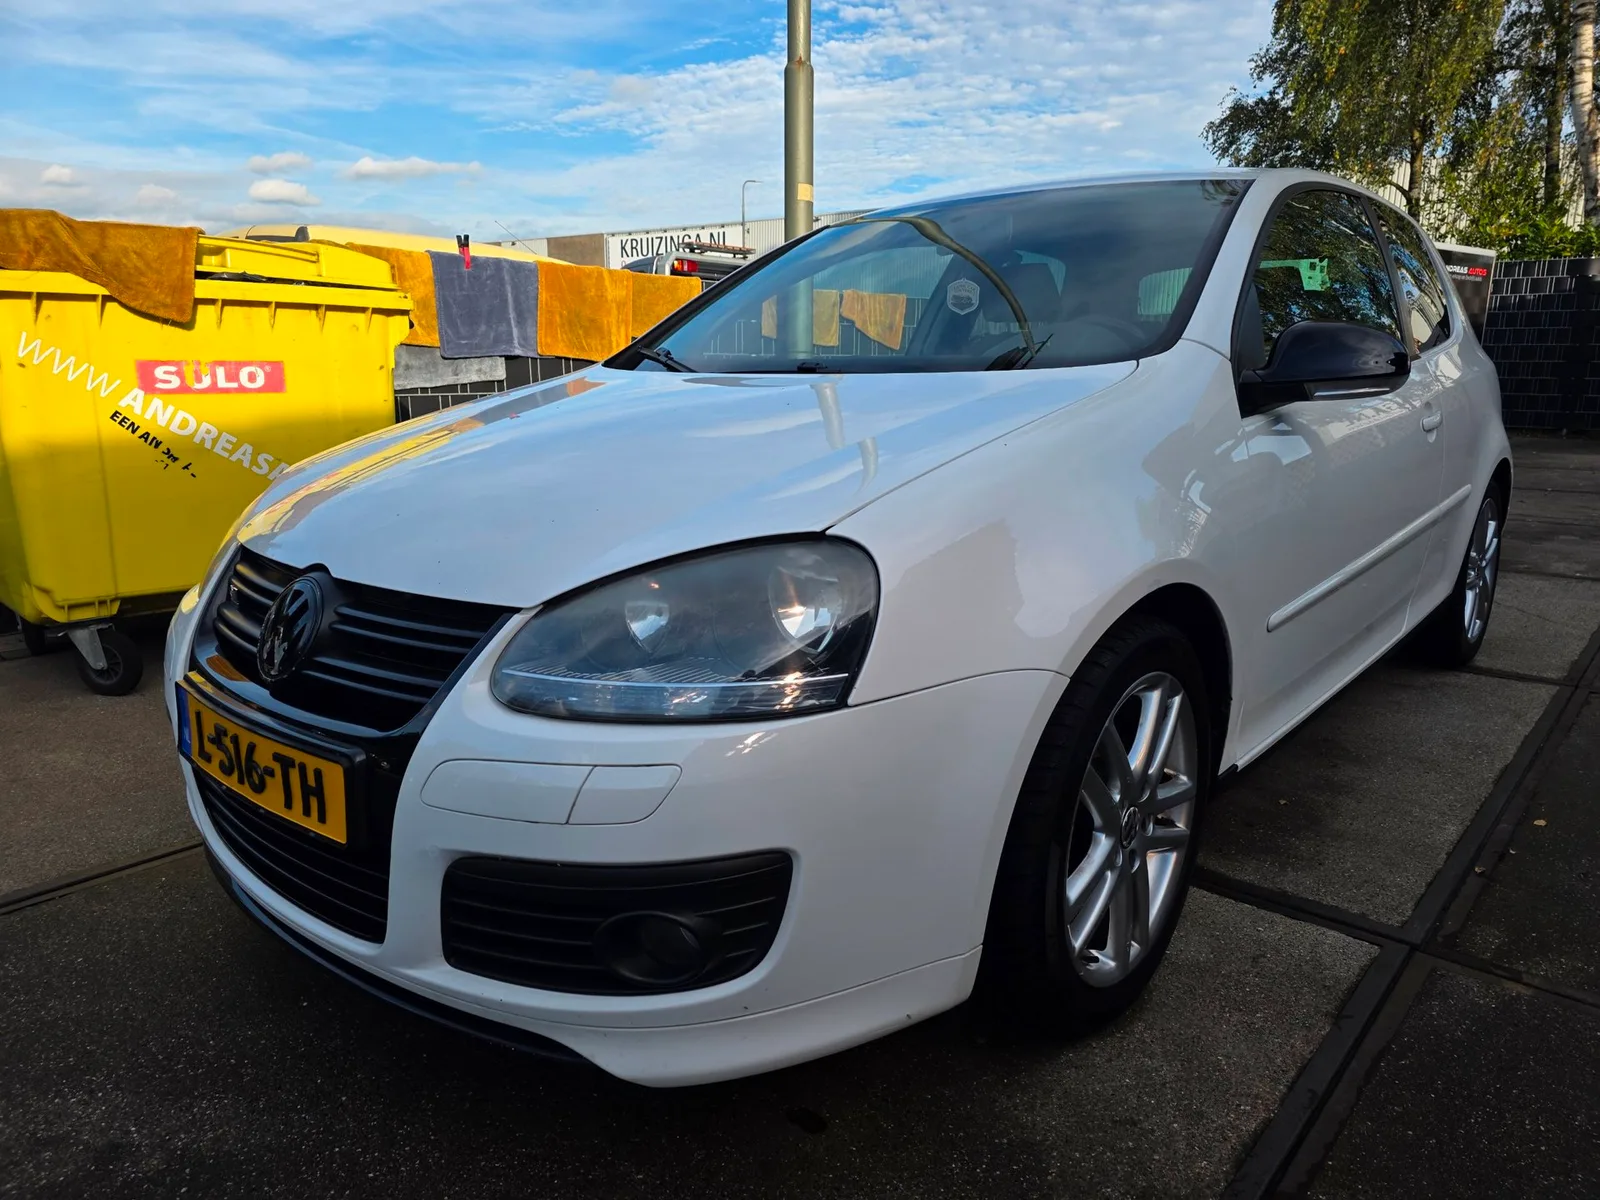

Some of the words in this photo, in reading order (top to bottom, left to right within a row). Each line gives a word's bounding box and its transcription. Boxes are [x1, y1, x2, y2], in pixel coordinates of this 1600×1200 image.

[18, 331, 121, 397] WWW
[109, 410, 141, 434] EEN
[195, 711, 327, 824] L-516-TH
